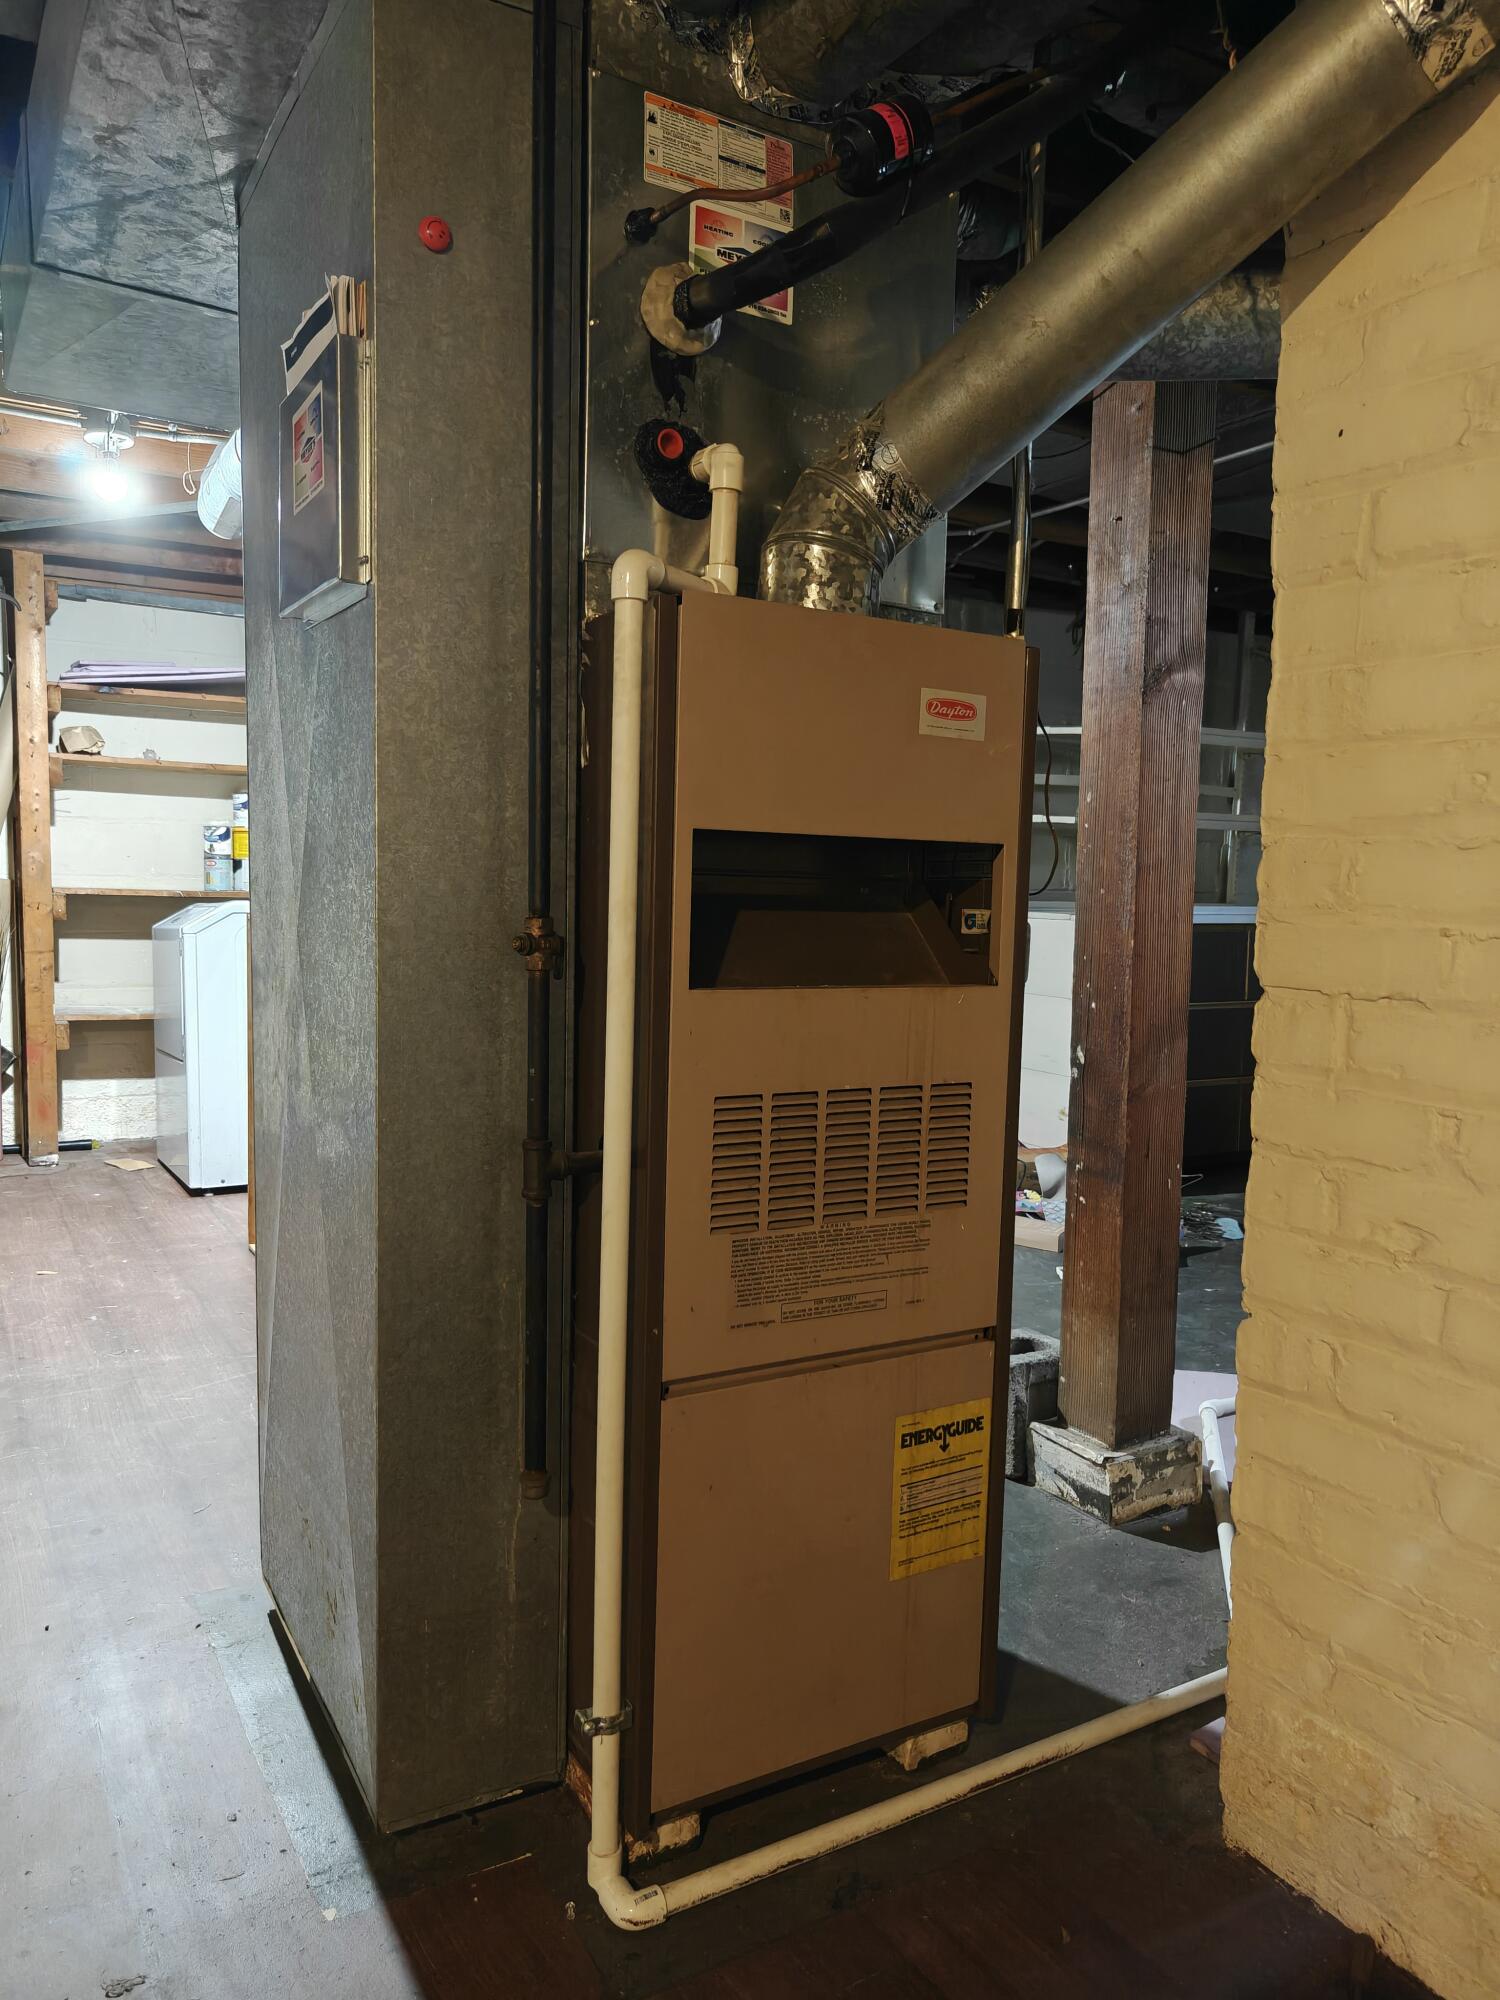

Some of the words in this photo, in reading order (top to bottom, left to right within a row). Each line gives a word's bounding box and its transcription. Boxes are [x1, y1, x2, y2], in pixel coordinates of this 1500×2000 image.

[704, 224, 734, 238] HEATING
[930, 701, 974, 719] Dayton
[901, 1415, 984, 1450] ENERGYGUIDE
